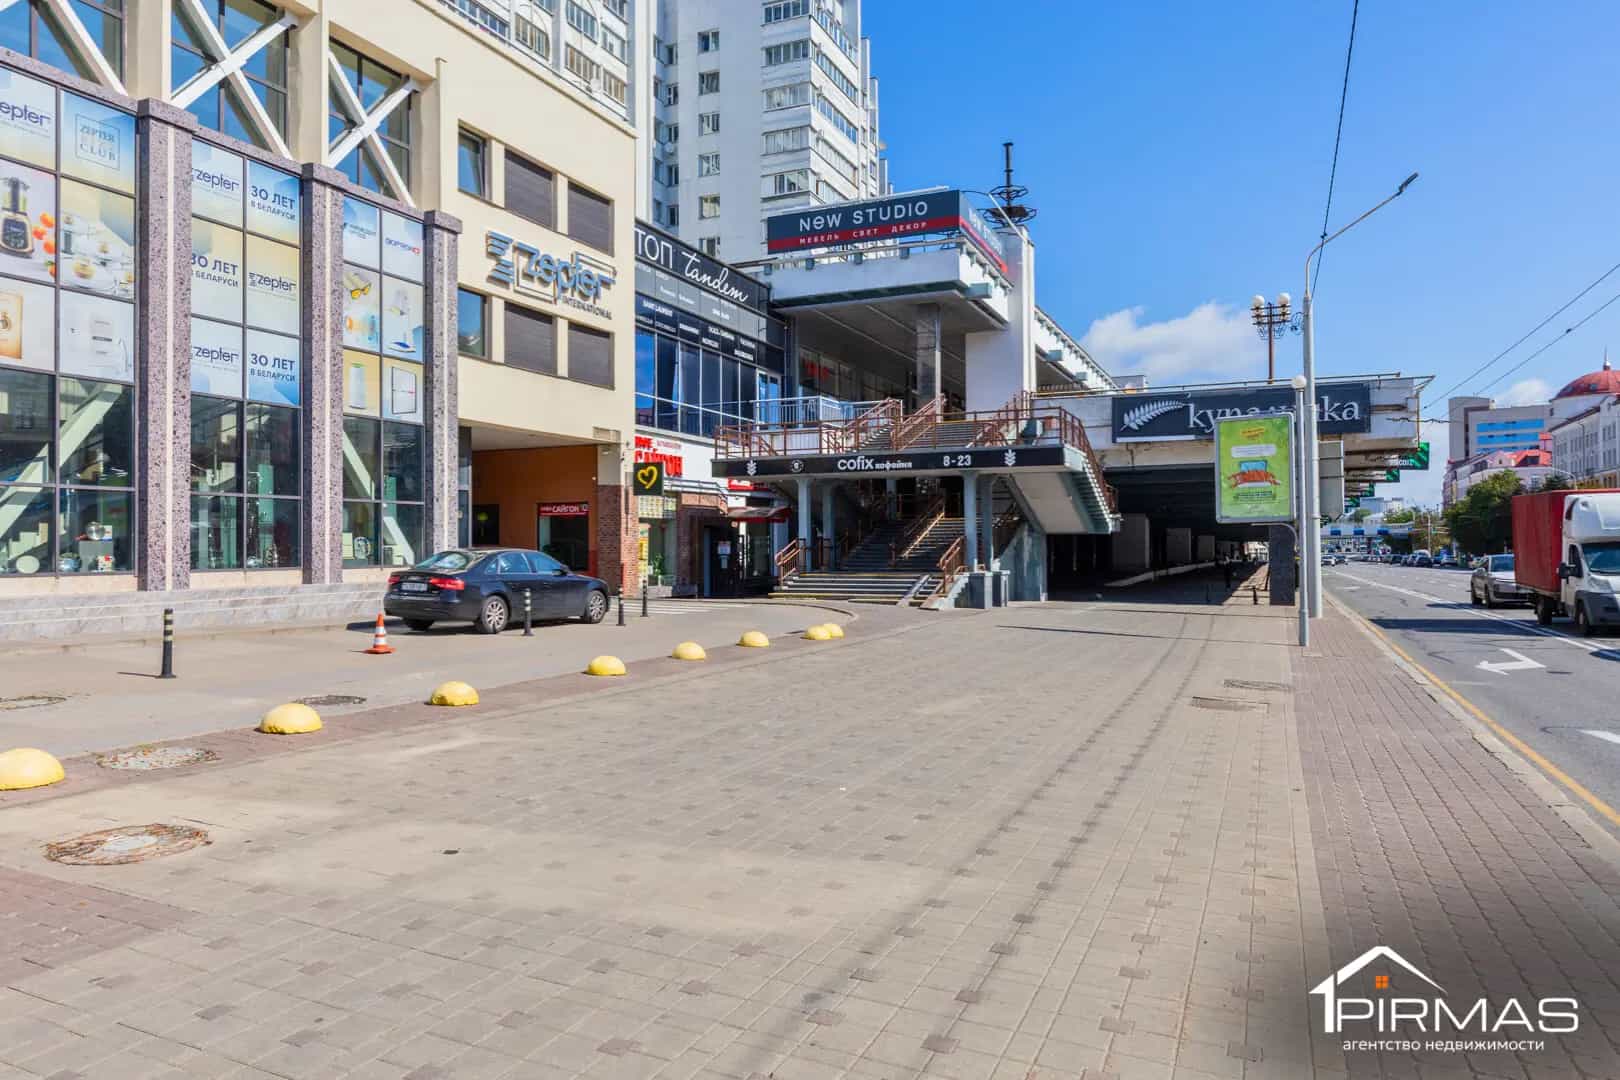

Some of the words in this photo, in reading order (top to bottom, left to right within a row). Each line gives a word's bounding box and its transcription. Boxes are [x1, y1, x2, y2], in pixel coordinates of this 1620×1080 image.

[0, 101, 51, 126] epter
[271, 193, 296, 210] ЛЕТ
[852, 201, 928, 225] STUDIO
[799, 233, 840, 245] МЕБЕЛЬ
[852, 228, 879, 239] СВЕТ
[891, 221, 928, 233] ДЕКОР
[212, 259, 239, 276] ЛЕТ
[195, 270, 239, 288] БЕЛАРУСИ
[250, 353, 269, 367] 30
[271, 356, 296, 371] ЛЕТ
[257, 369, 296, 383] БЕЛАРУСИ
